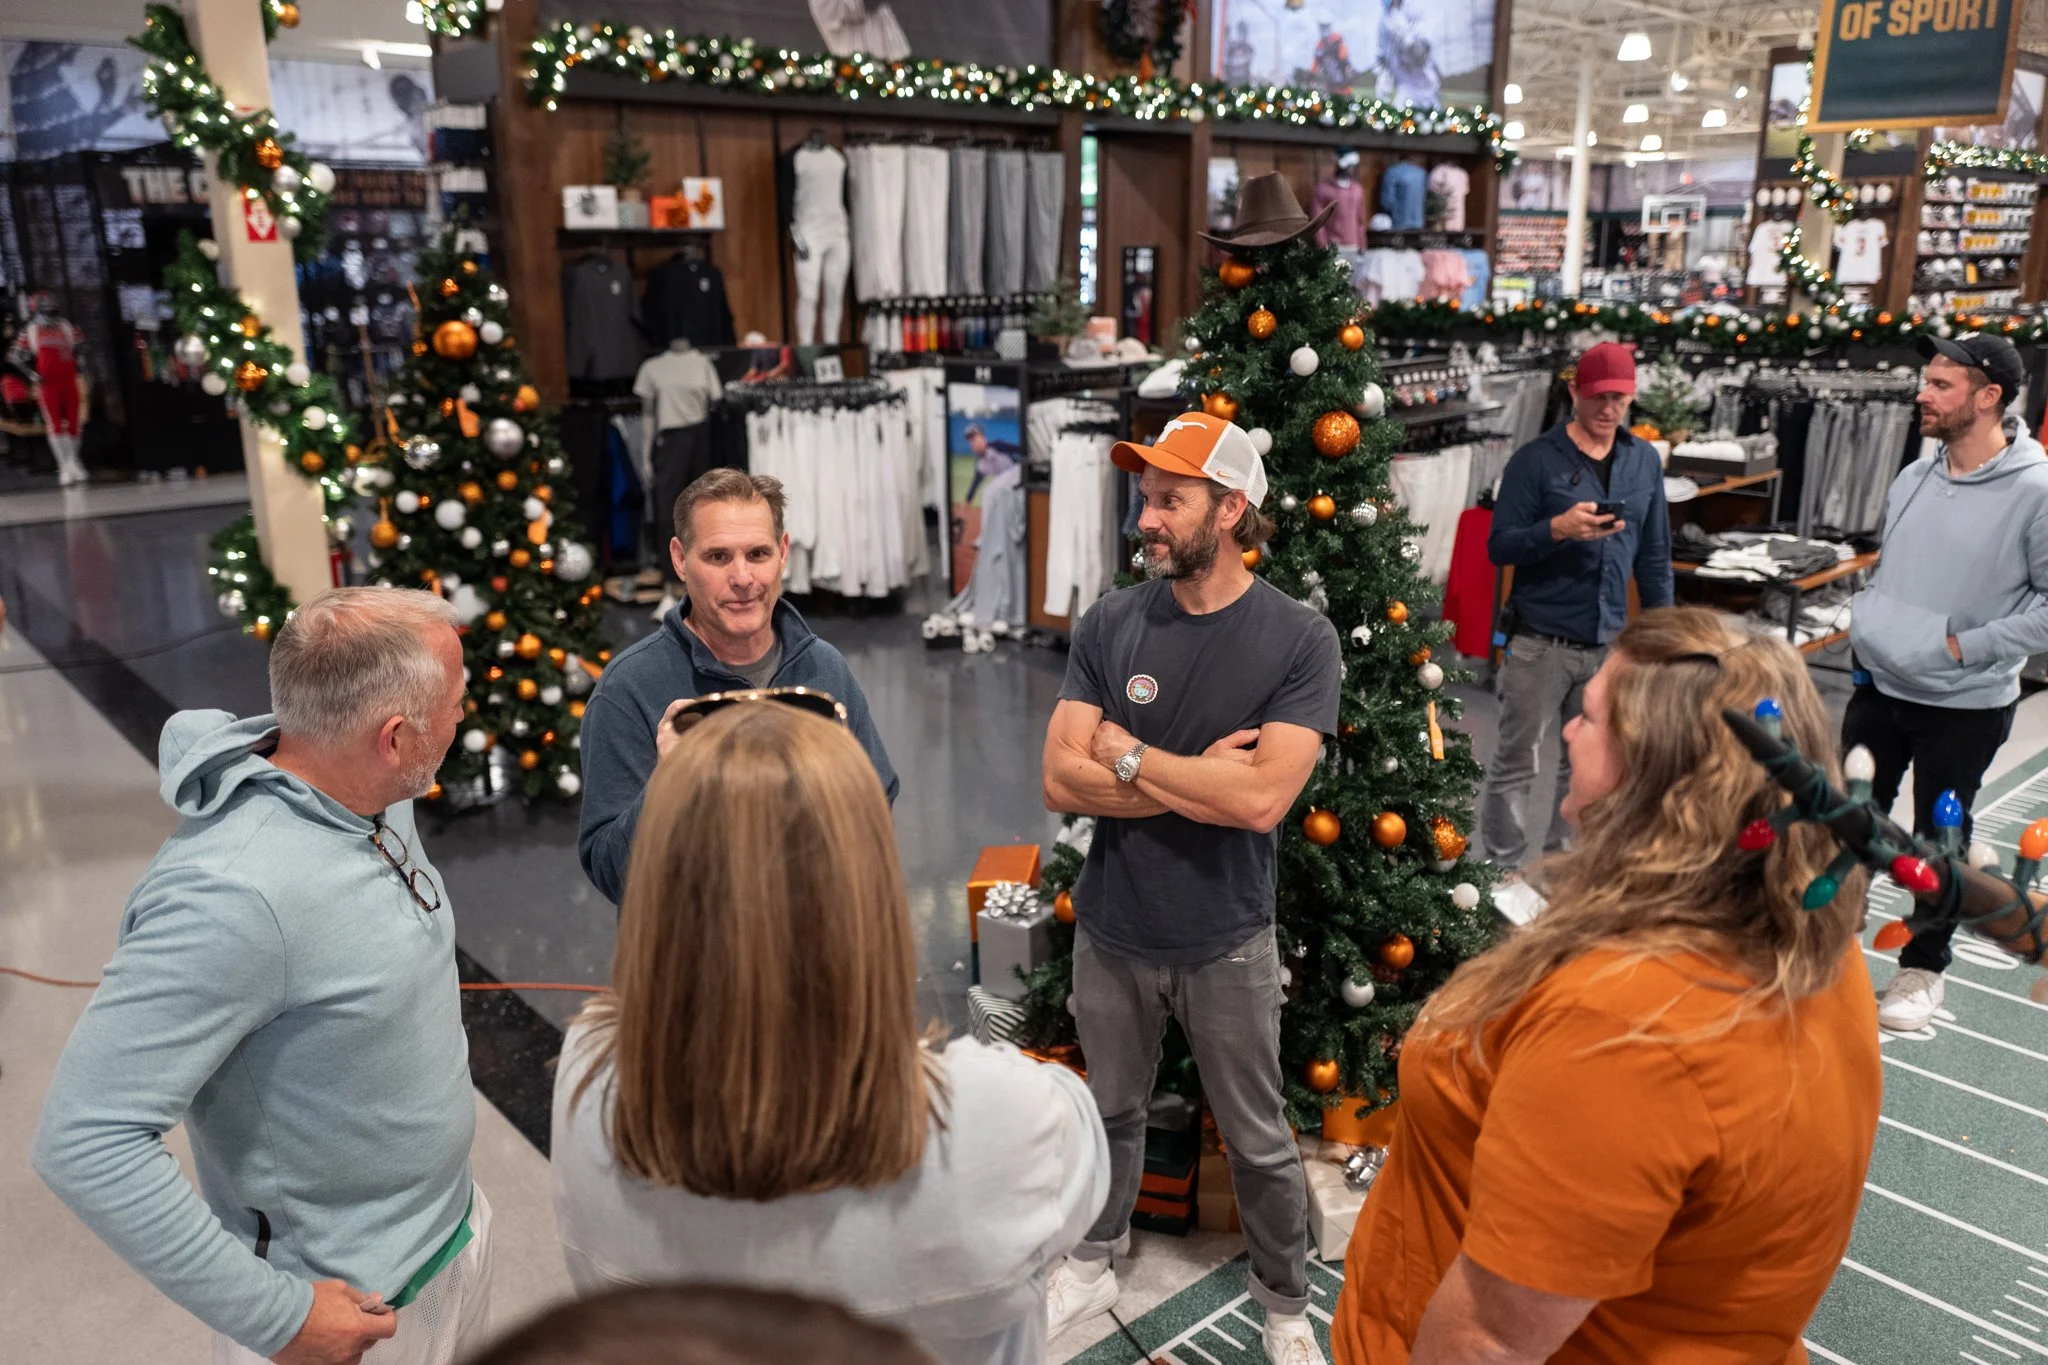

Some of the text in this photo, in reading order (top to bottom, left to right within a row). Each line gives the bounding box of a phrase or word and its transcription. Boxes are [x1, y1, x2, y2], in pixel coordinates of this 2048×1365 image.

[1838, 0, 1998, 41] OF SPORT
[121, 165, 188, 204] THE
